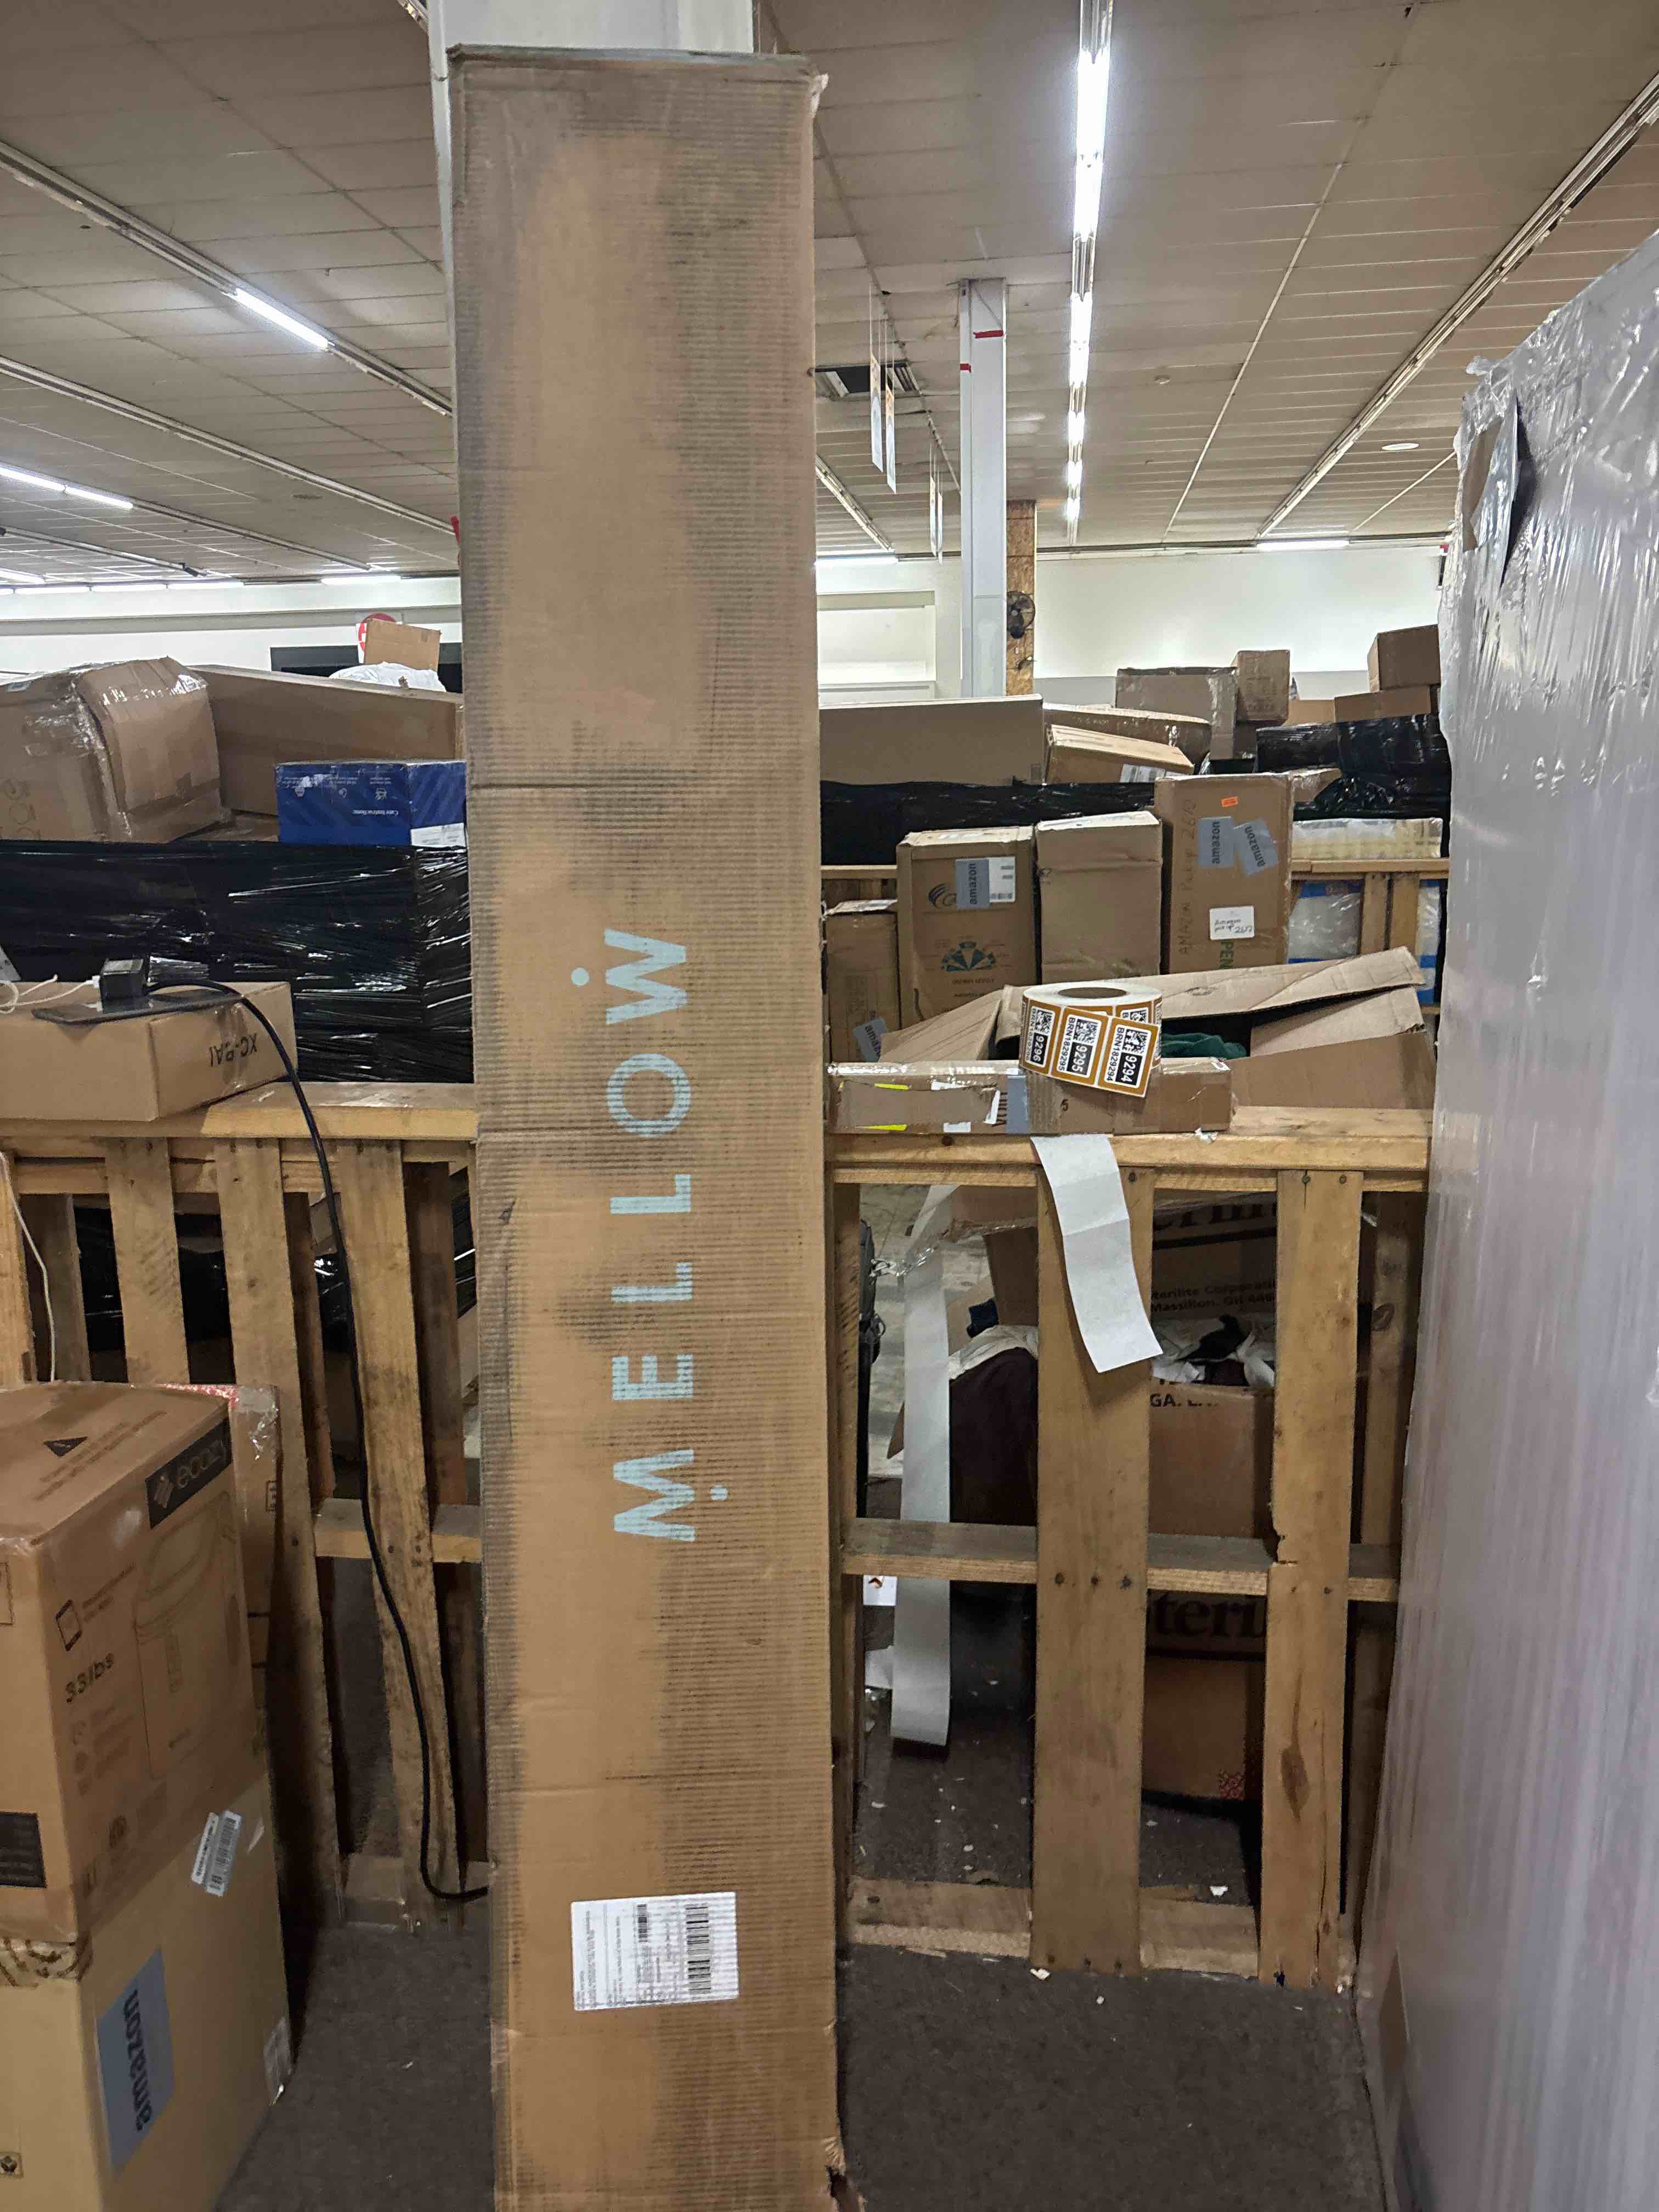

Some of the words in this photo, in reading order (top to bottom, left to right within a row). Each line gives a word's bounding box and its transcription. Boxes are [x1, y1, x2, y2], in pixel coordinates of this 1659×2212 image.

[1212, 822, 1221, 865] amazon
[1245, 825, 1265, 868] amazon
[968, 862, 977, 905] amazon
[1033, 1035, 1045, 1062] 9296
[1057, 1017, 1076, 1072] BRN1829295
[1071, 1045, 1087, 1073] 9295
[1105, 1026, 1125, 1082] BRN1829294
[1120, 1055, 1138, 1082] 9294
[603, 927, 696, 1543] MELLOW
[122, 1989, 154, 2132] amazon
